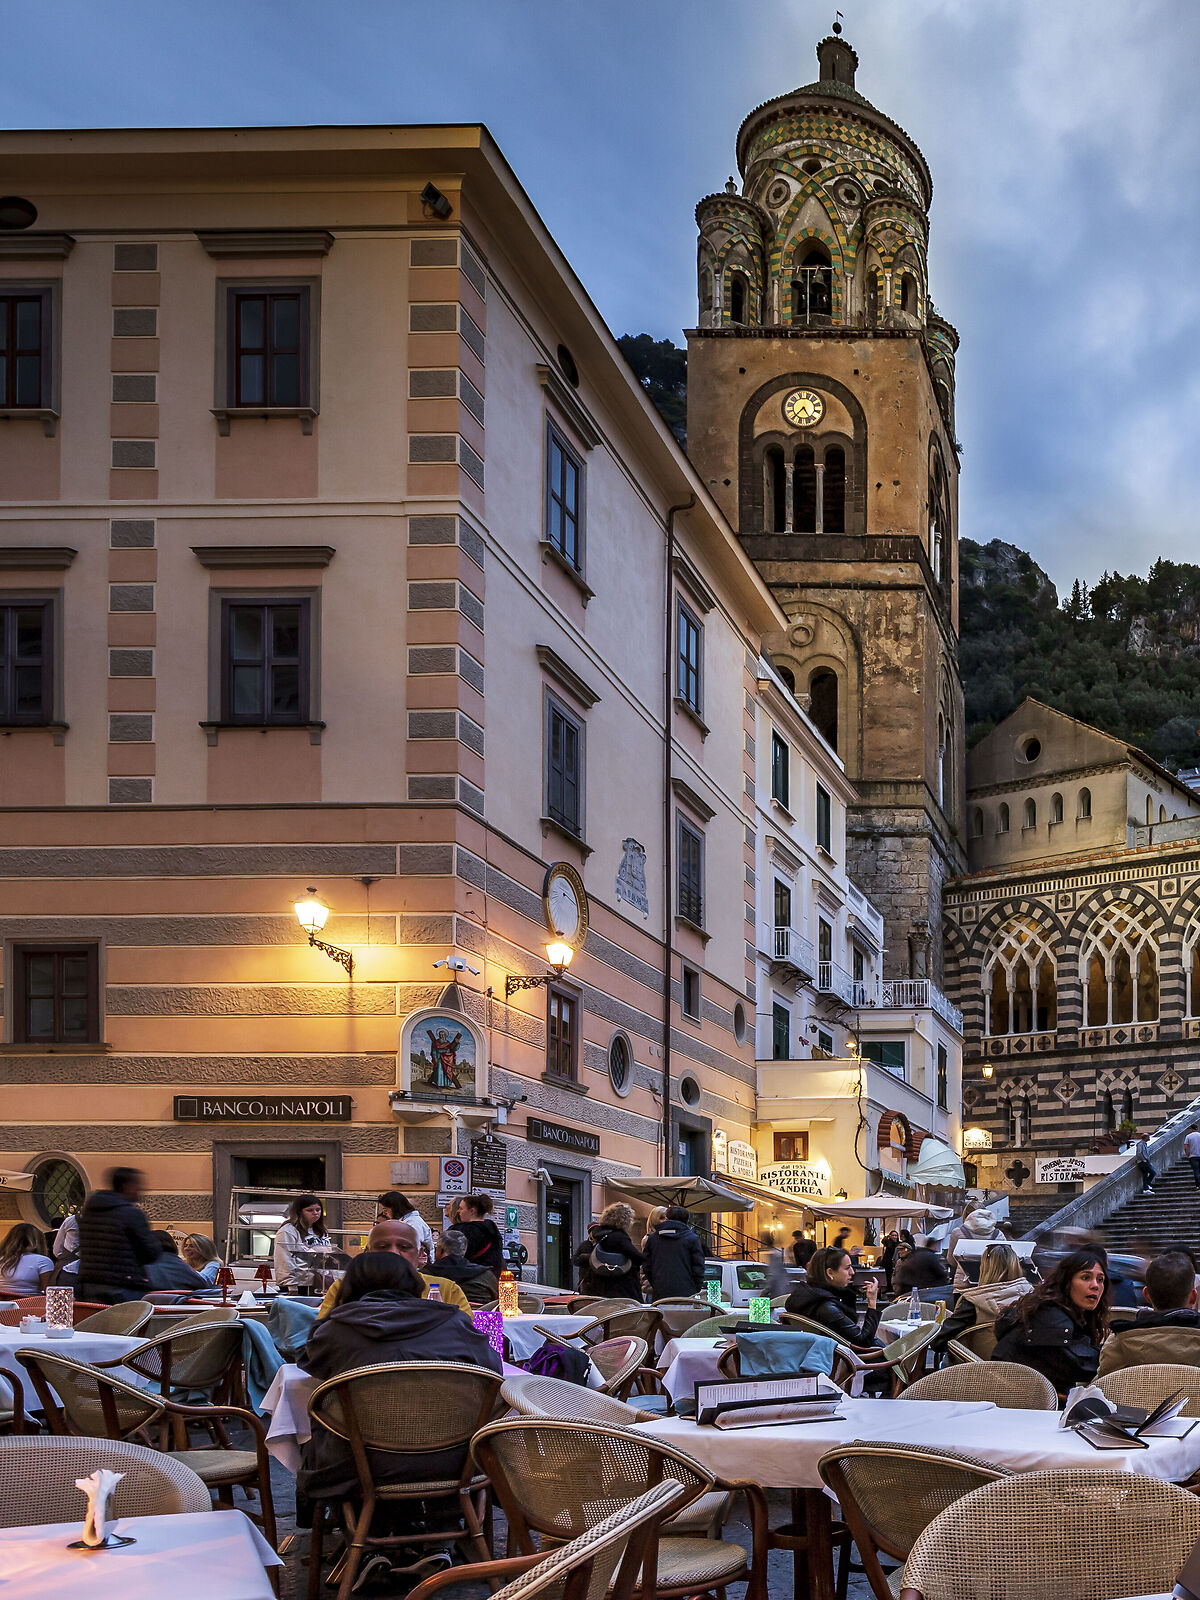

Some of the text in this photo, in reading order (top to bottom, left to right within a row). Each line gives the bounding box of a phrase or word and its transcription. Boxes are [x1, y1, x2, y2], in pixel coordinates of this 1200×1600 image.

[203, 1101, 343, 1116] BANCO DI NAPOLI
[543, 1125, 568, 1143] BANCO
[574, 1135, 599, 1151] NAPOLI
[730, 1146, 755, 1161] RISTORANTE
[733, 1157, 752, 1169] PIZZERIA
[769, 1177, 818, 1187] PIZZERIA
[779, 1185, 824, 1196] ANDREA
